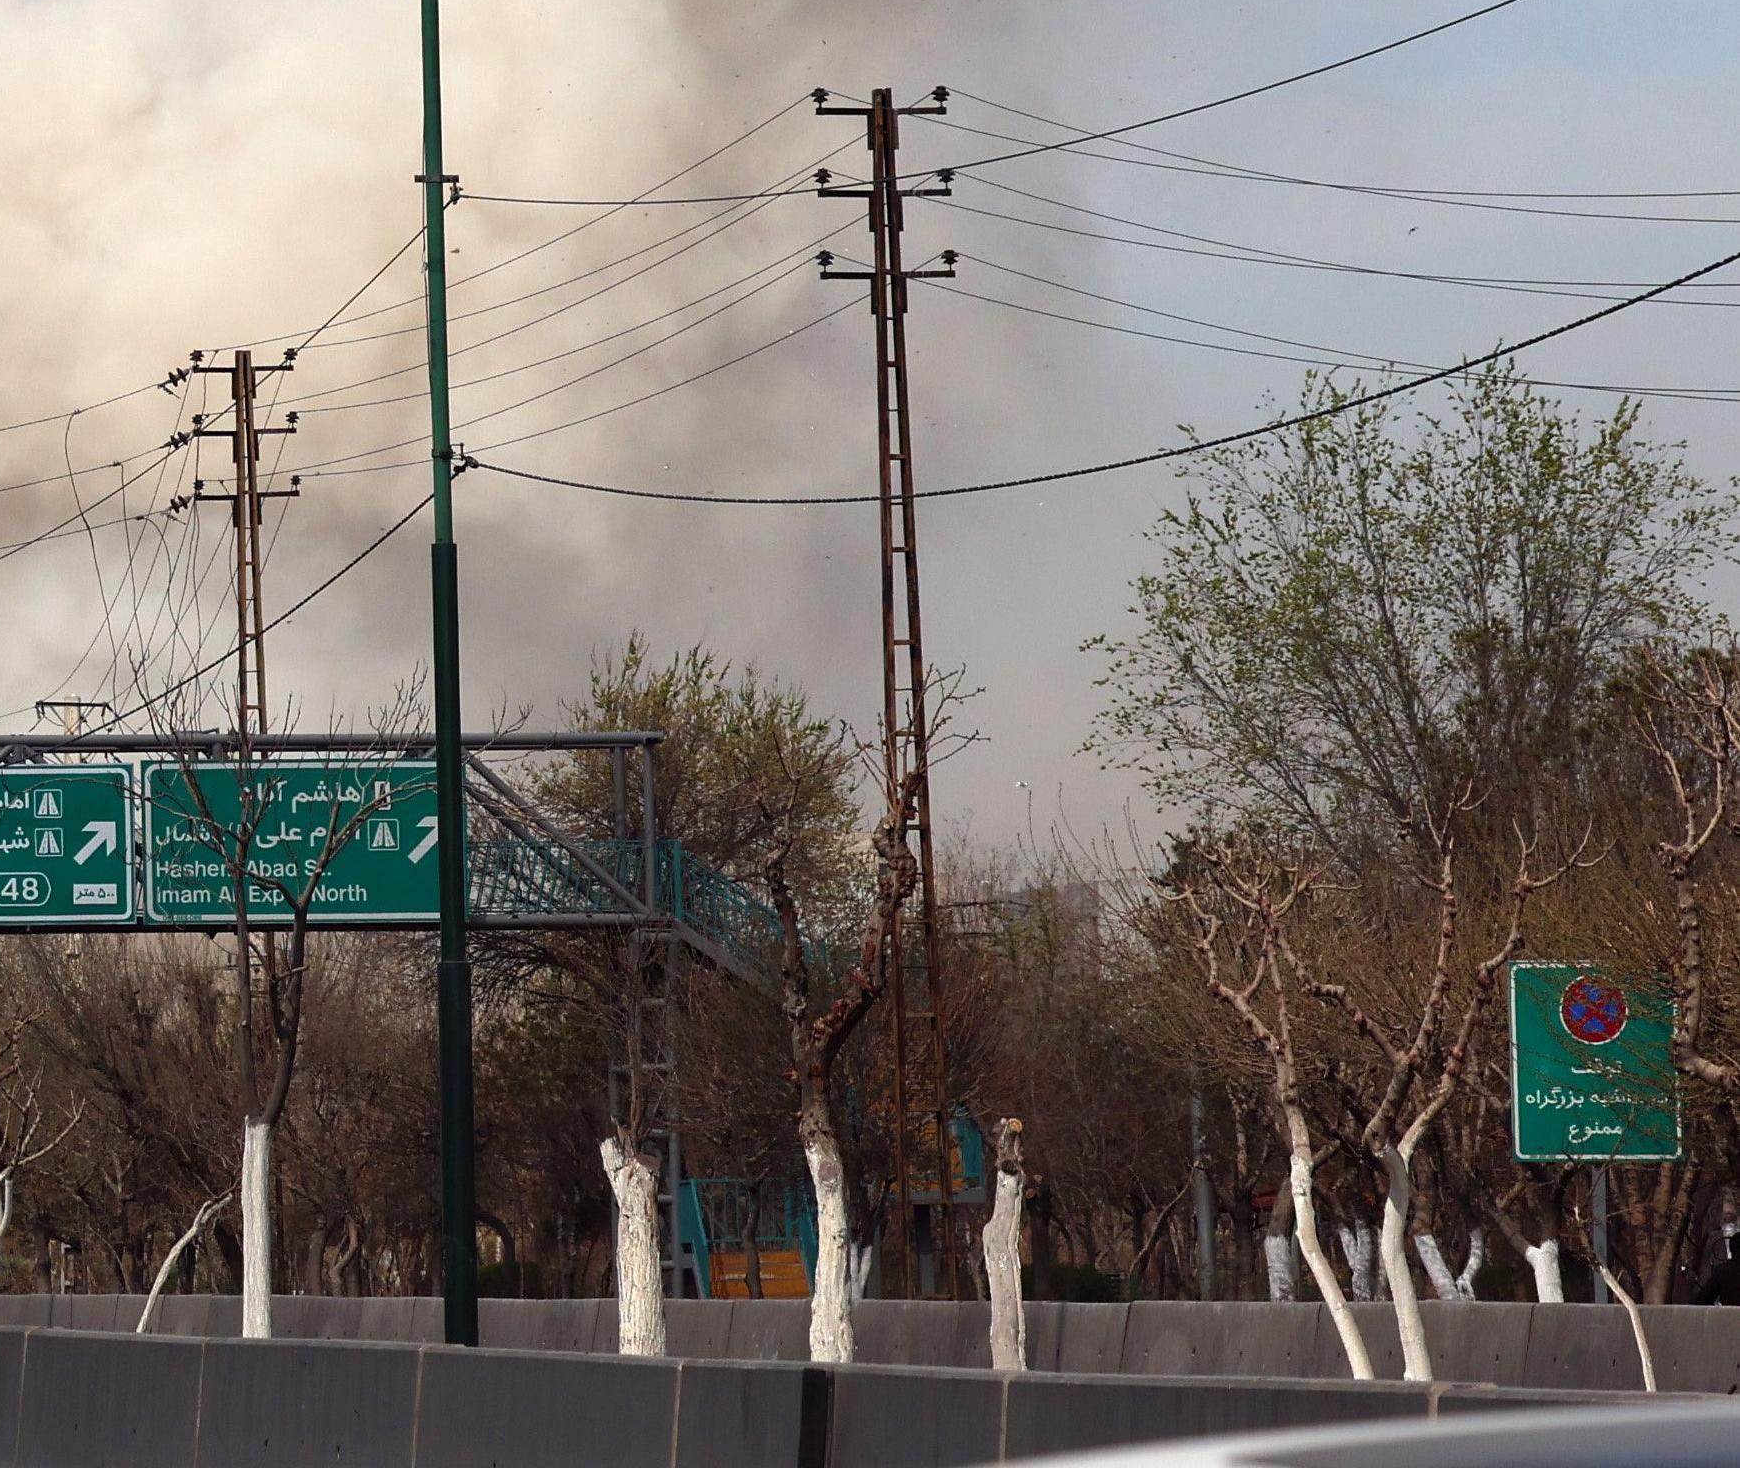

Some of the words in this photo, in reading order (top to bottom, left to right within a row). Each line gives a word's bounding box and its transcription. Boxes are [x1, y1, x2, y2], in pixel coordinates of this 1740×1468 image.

[291, 780, 361, 814] هاشم
[0, 877, 39, 902] 48
[75, 887, 96, 901] متر
[97, 887, 116, 899] ۵۰۰
[156, 885, 211, 904] Imam
[311, 884, 367, 903] North
[1525, 1086, 1585, 1110] بزرگراه
[1568, 1121, 1623, 1144] ممنوع
